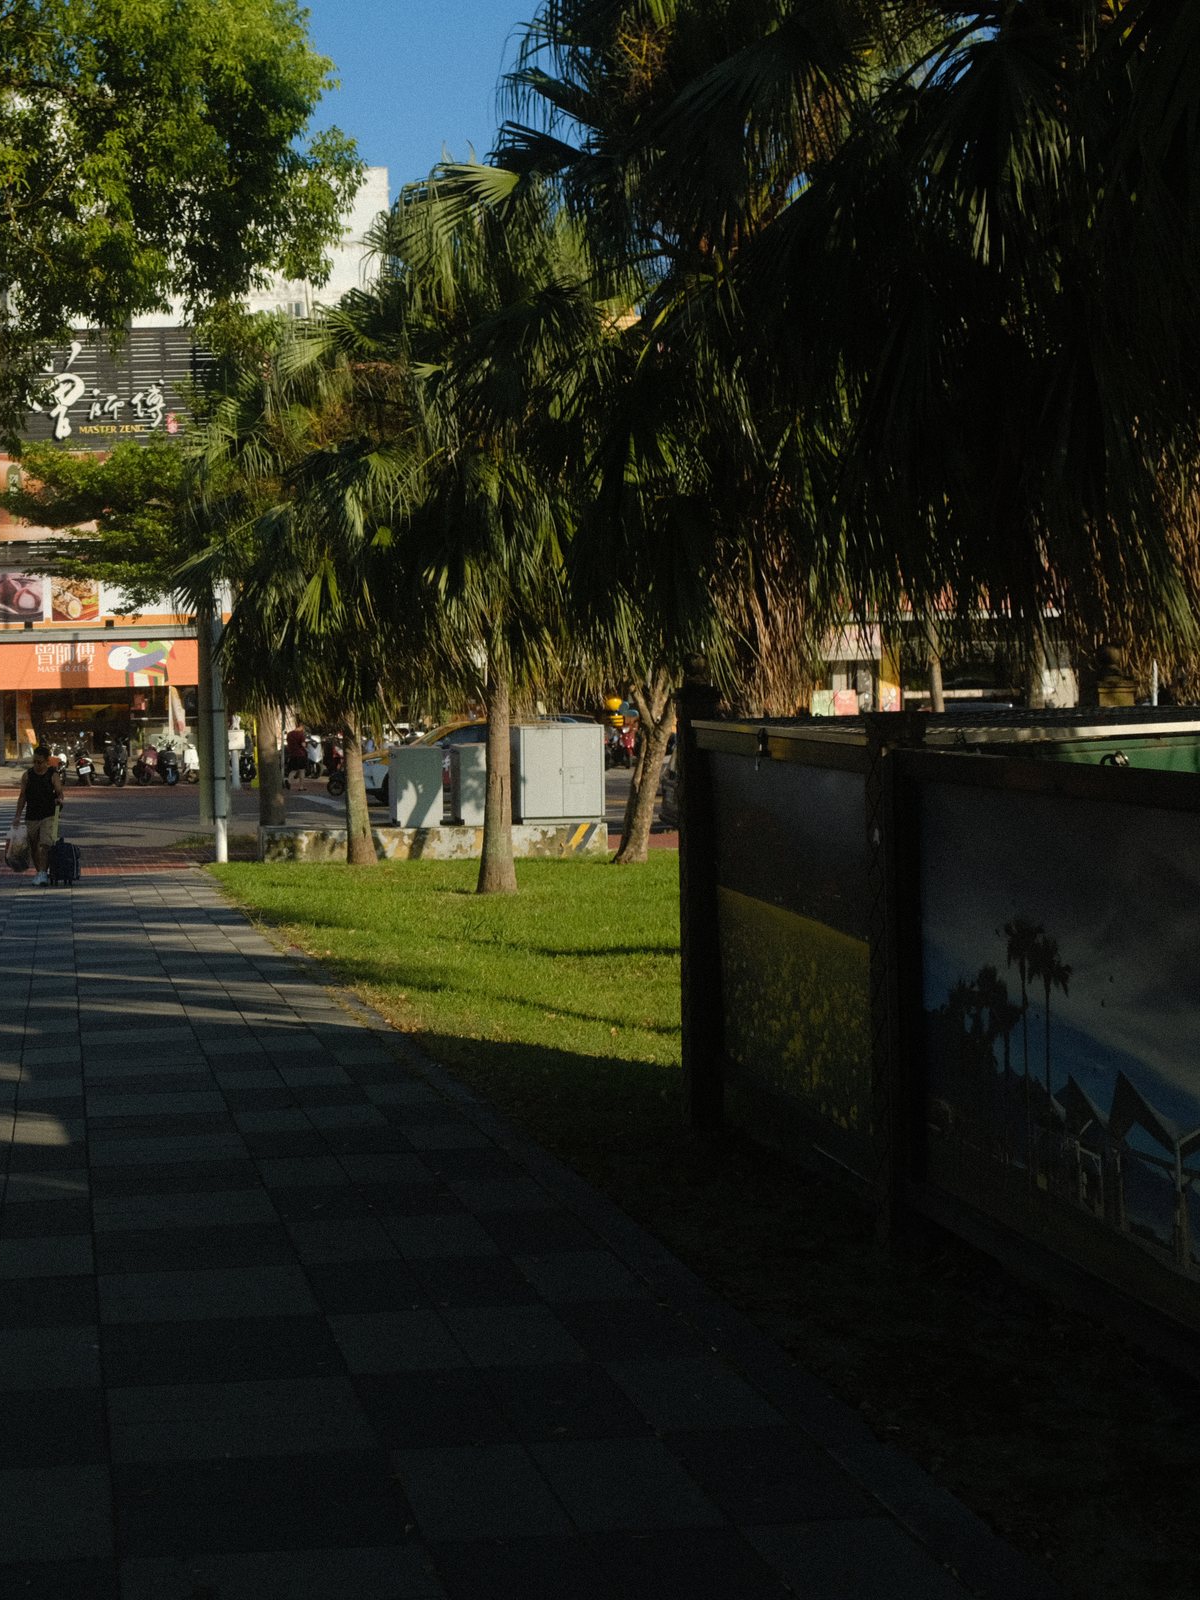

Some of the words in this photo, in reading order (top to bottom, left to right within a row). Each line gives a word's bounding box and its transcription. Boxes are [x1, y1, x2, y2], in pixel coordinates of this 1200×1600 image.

[79, 425, 117, 434] MASTER
[119, 424, 145, 433] ZENG
[35, 642, 95, 665] 曾師傅
[73, 664, 94, 672] ZENG
